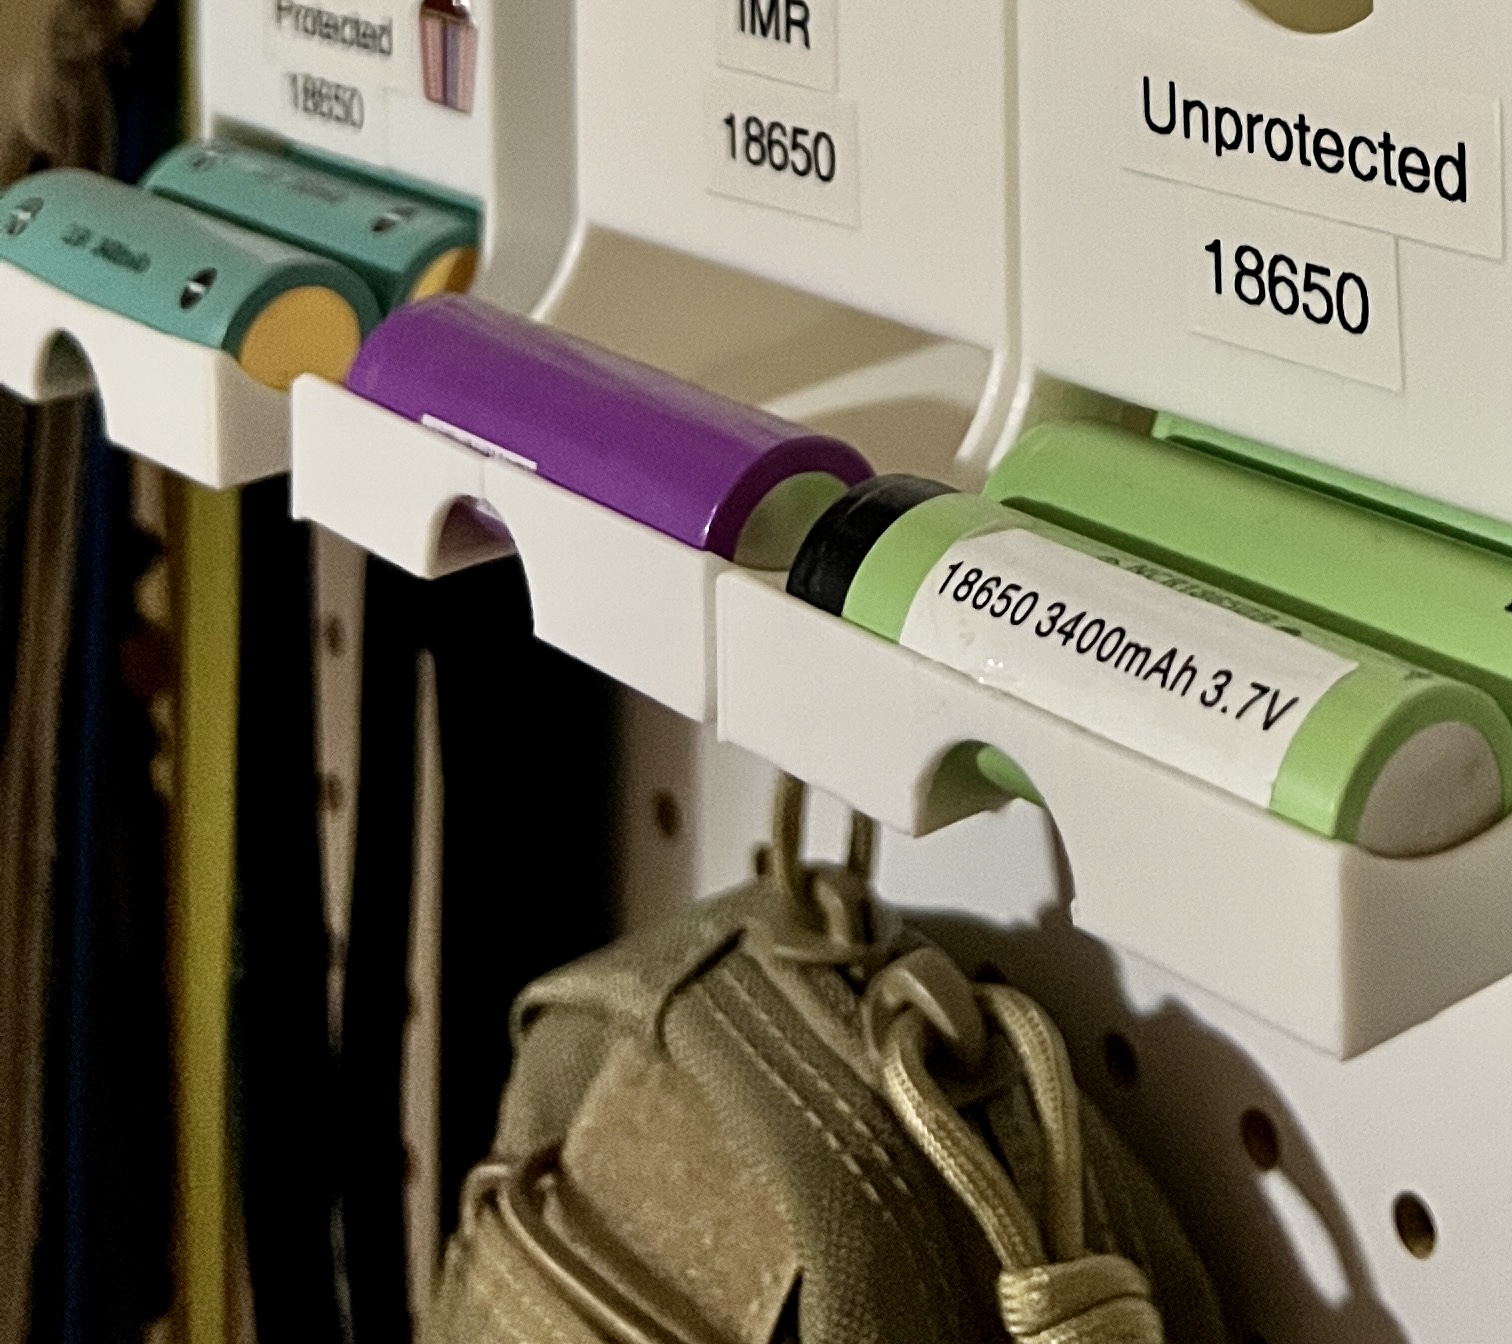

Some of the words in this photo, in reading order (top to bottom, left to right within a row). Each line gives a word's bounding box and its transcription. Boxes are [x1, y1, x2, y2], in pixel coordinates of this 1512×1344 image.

[287, 72, 364, 130] 18650
[723, 112, 836, 184] 18650
[1142, 75, 1468, 204] Unprotected
[1204, 237, 1370, 336] 18650
[938, 560, 1039, 627] 18650
[1034, 602, 1198, 697] 3400mAh
[1199, 669, 1299, 731] 3.7V
